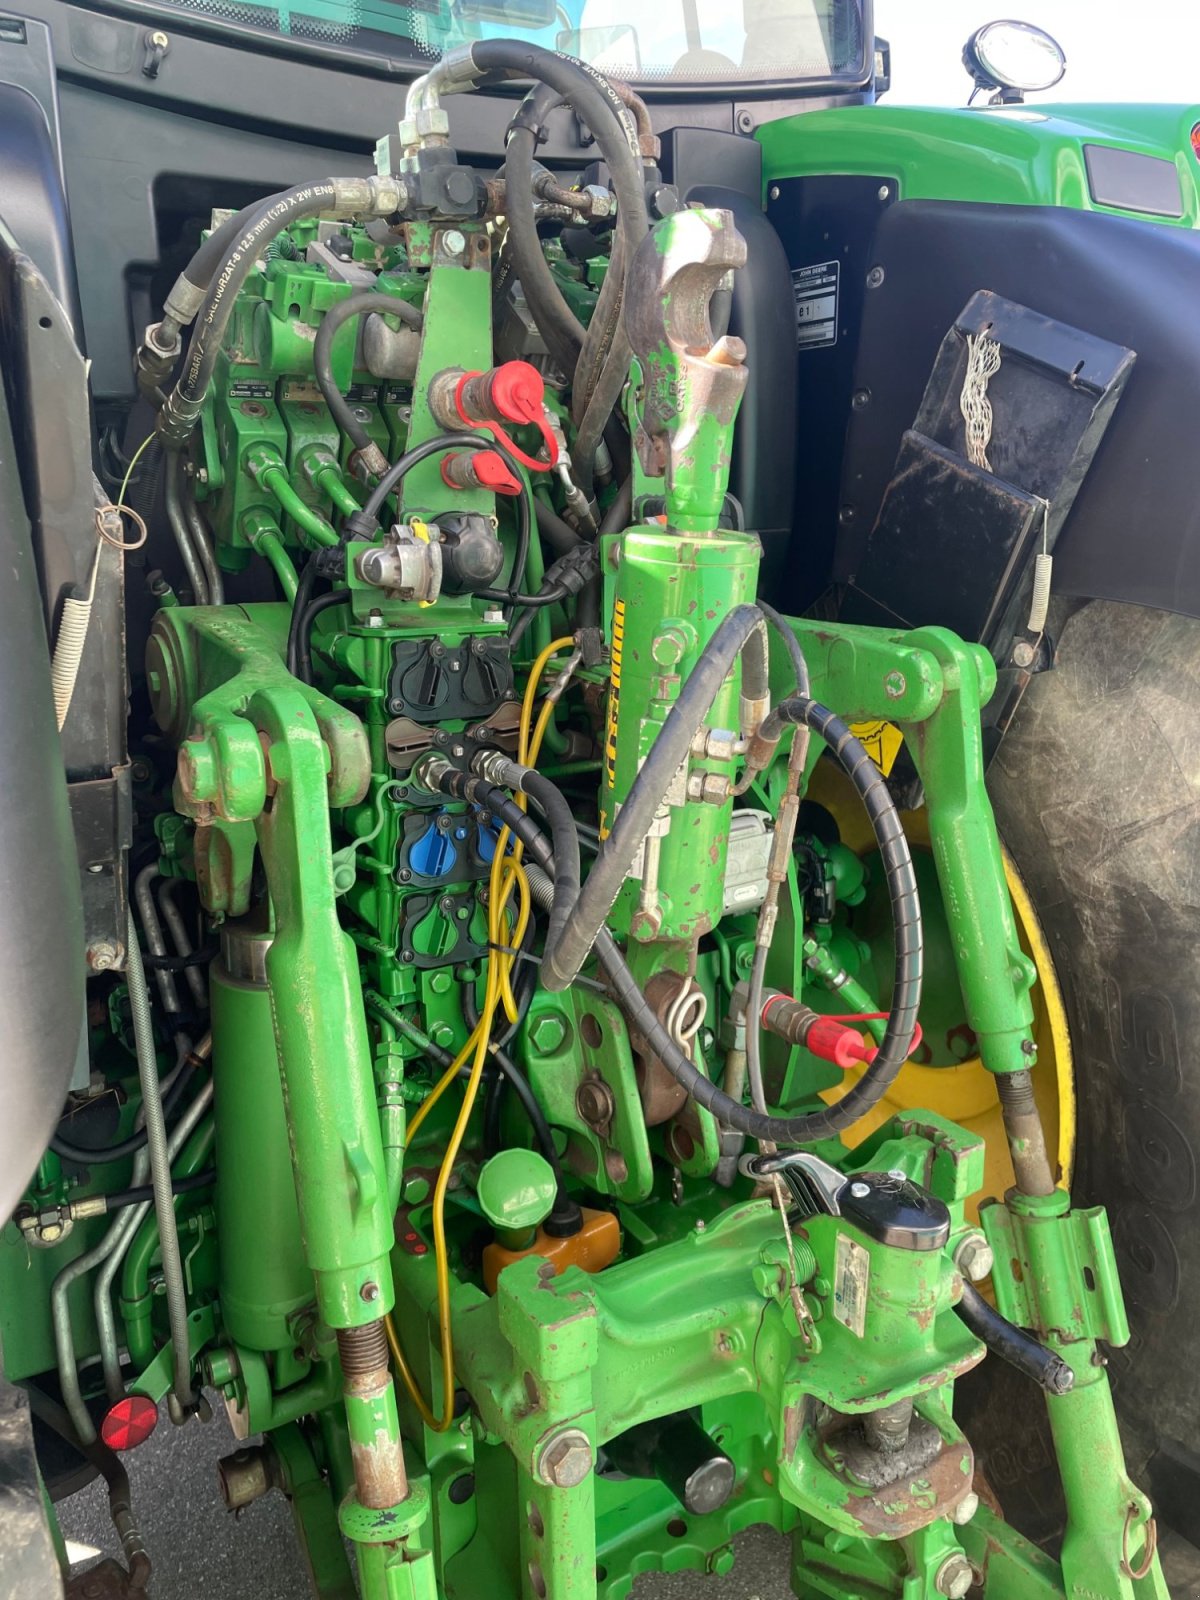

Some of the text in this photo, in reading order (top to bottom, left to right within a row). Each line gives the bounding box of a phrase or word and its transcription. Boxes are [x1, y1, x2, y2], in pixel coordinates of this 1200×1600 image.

[582, 64, 621, 105] NO-SKIVE
[239, 233, 255, 253] 12,5
[255, 218, 270, 235] mm
[267, 200, 289, 220] (1/2)
[287, 197, 297, 206] X
[296, 188, 312, 202] 2W
